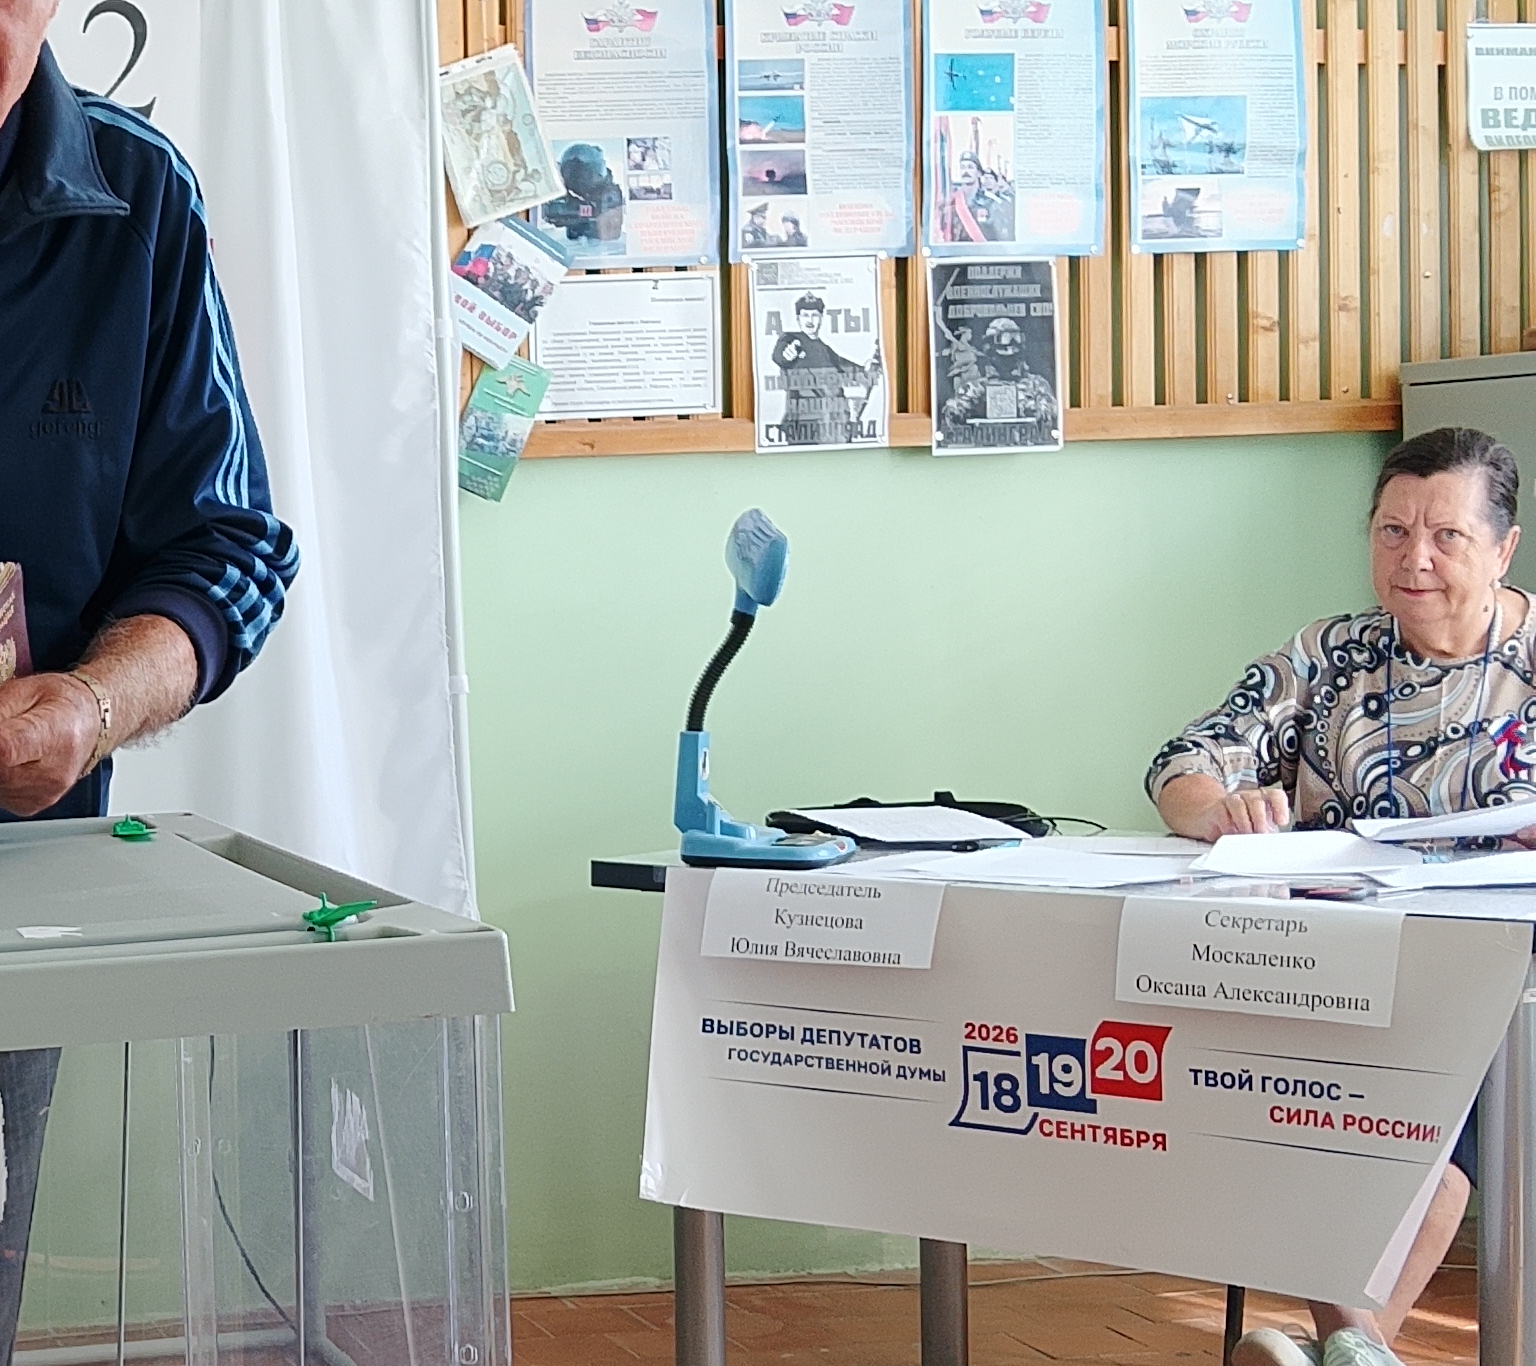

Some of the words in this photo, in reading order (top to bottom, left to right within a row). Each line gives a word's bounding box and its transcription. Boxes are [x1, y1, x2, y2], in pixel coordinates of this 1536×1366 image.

[82, 0, 157, 121] 2
[1494, 85, 1504, 101] В
[765, 311, 782, 335] А
[826, 307, 871, 334] ТЫ
[766, 877, 882, 899] Председатель
[774, 908, 863, 930] Кузнецова
[1205, 909, 1308, 937] Секретарь
[731, 937, 778, 956] Юлия
[784, 940, 901, 965] Вячеславовна
[1191, 943, 1316, 970] Москаленко
[1136, 974, 1206, 998] Оксана
[1213, 981, 1370, 1012] Александровна
[701, 1017, 794, 1042] ВЫБОРЫ
[800, 1027, 922, 1055] ДЕПУТАТОВ
[964, 1022, 1019, 1045] 2026
[728, 1047, 892, 1077] ГОСУДАРСТВЕННОЙ
[895, 1064, 946, 1083] ДУМЫ
[972, 1070, 1022, 1114] 18
[1031, 1052, 1083, 1097] 19
[1094, 1036, 1159, 1084] 20
[1188, 1068, 1253, 1092] ТВОЙ
[1261, 1075, 1342, 1101] ГОЛОС
[1038, 1118, 1167, 1152] СЕНТЯБРЯ
[1269, 1105, 1335, 1130] СИЛА
[1342, 1113, 1442, 1144] РОССИИ!
